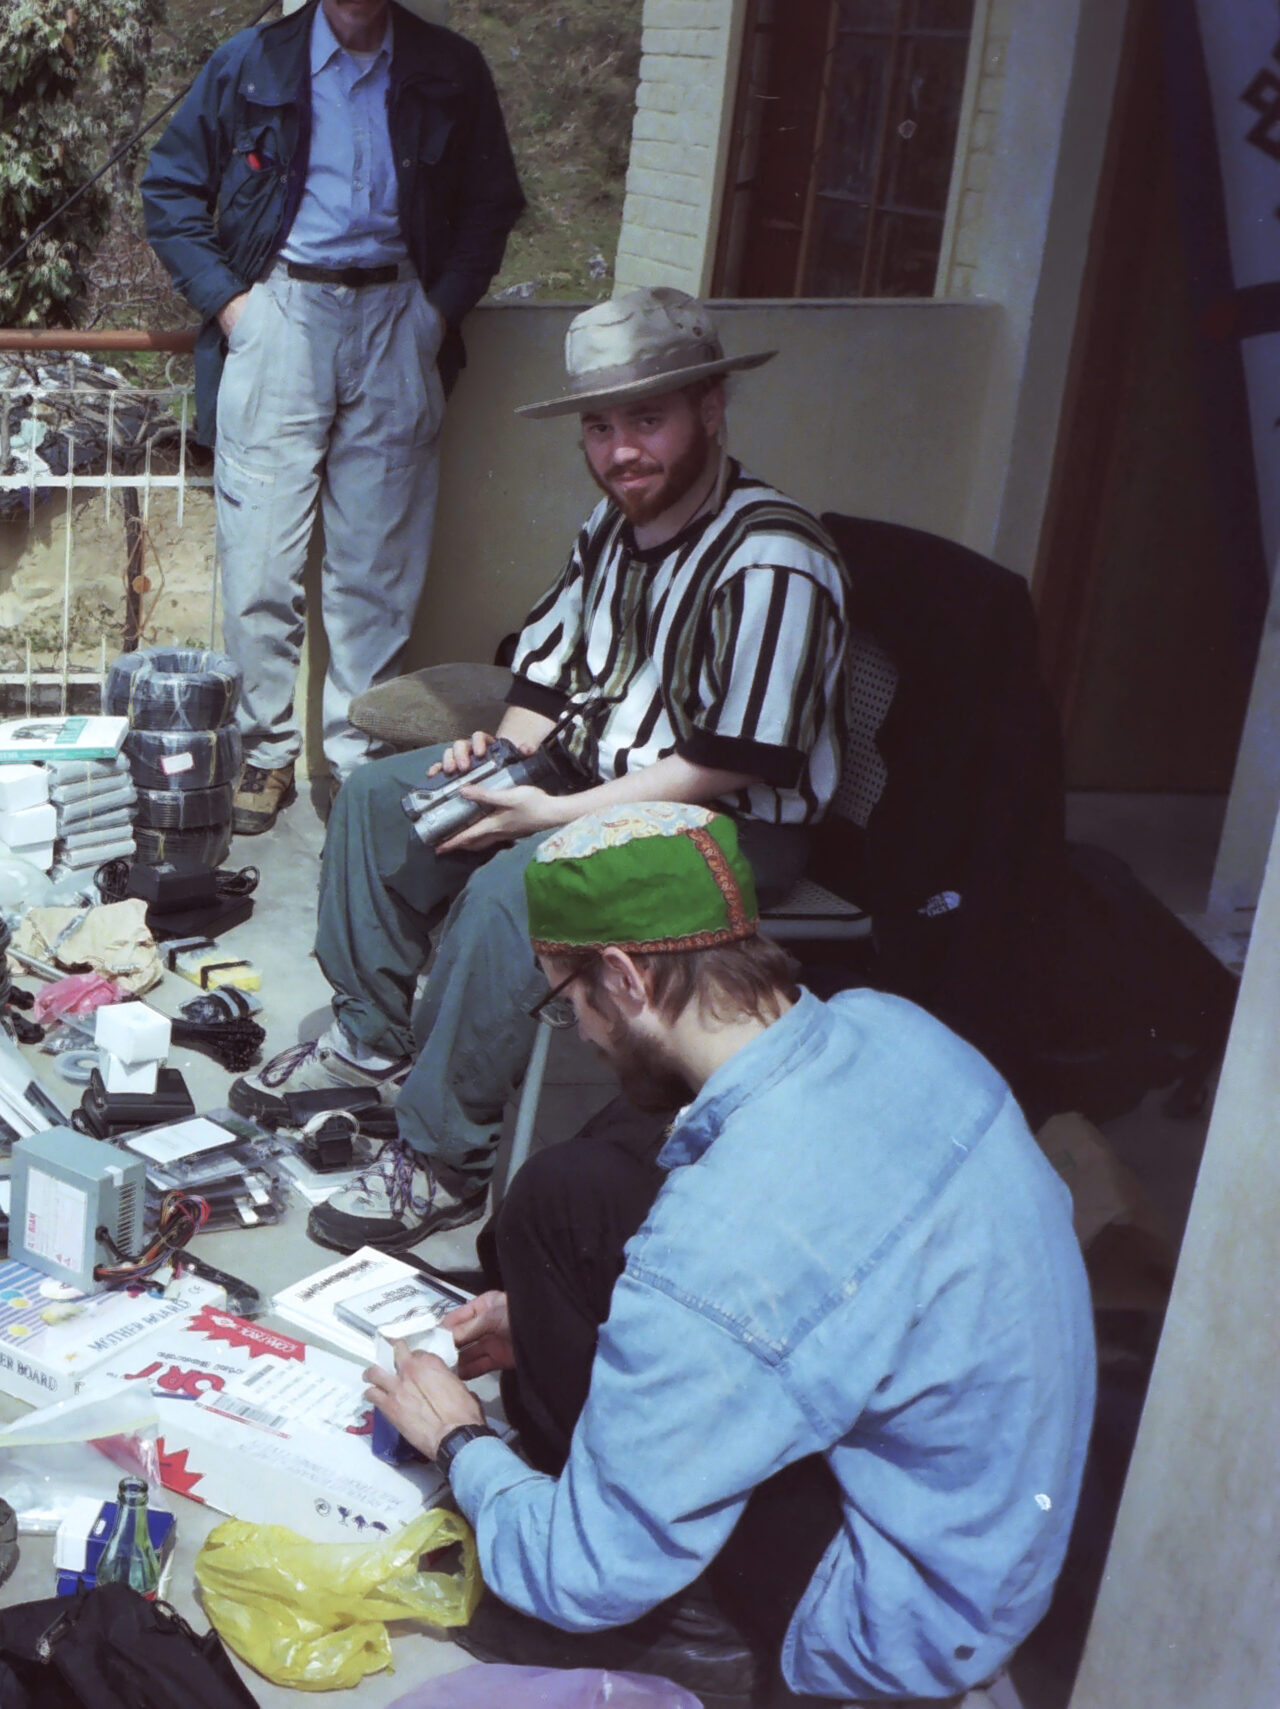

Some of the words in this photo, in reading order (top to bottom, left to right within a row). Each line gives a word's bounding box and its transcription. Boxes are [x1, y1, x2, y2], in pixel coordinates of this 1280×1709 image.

[88, 1322, 145, 1352] MOTHER
[142, 1297, 191, 1326] BOARD
[16, 1359, 58, 1392] BOARD
